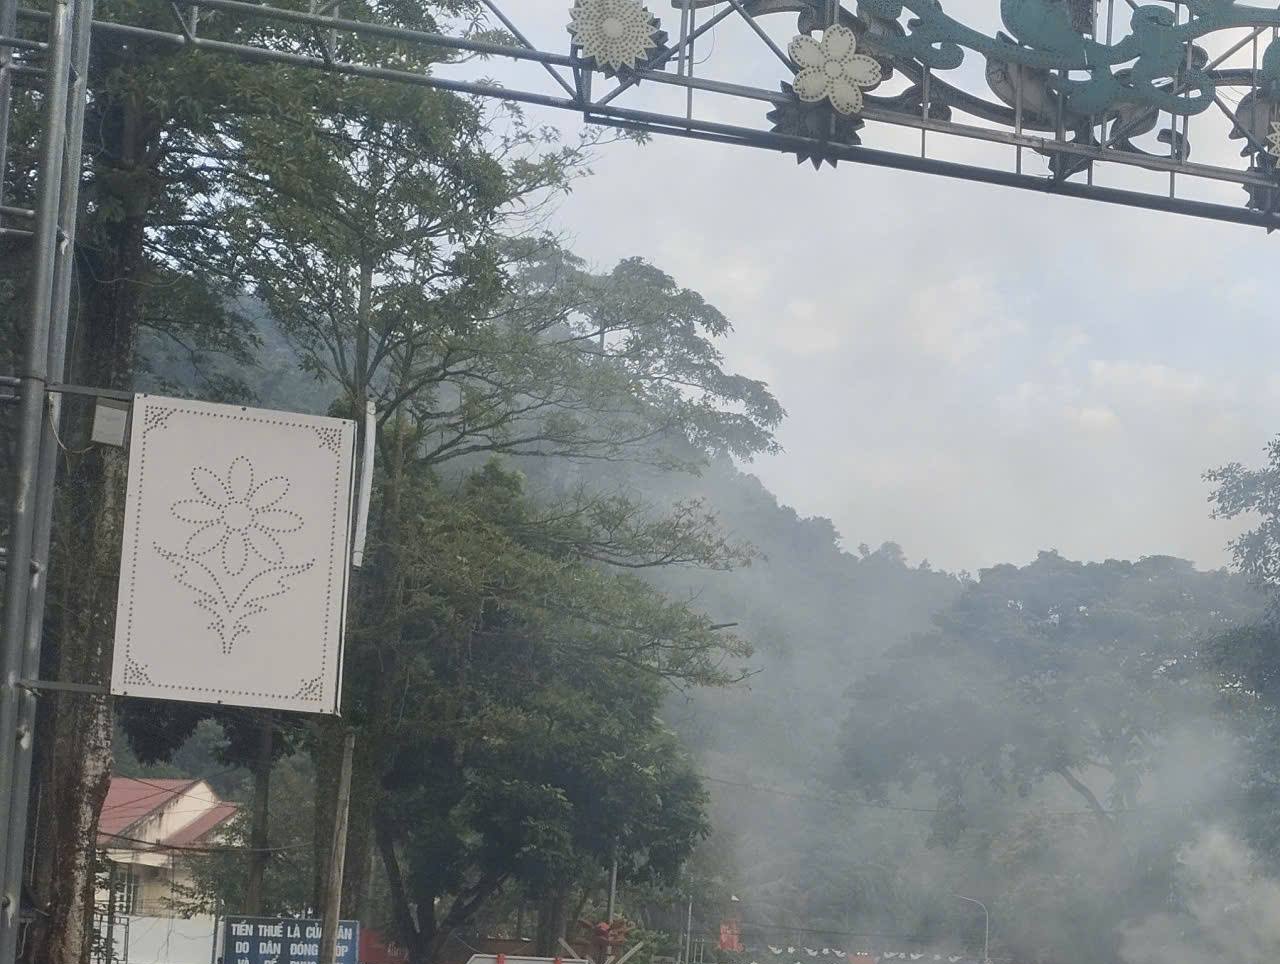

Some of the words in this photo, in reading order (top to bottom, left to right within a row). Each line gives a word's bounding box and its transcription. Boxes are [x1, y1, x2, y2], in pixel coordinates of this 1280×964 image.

[258, 921, 284, 937] THUẾ
[287, 923, 301, 938] LÀ
[337, 926, 352, 940] ÂN
[235, 941, 249, 954] DO
[259, 940, 281, 955] DÂN
[289, 941, 318, 956] ĐÓNG
[336, 943, 348, 957] ÓP
